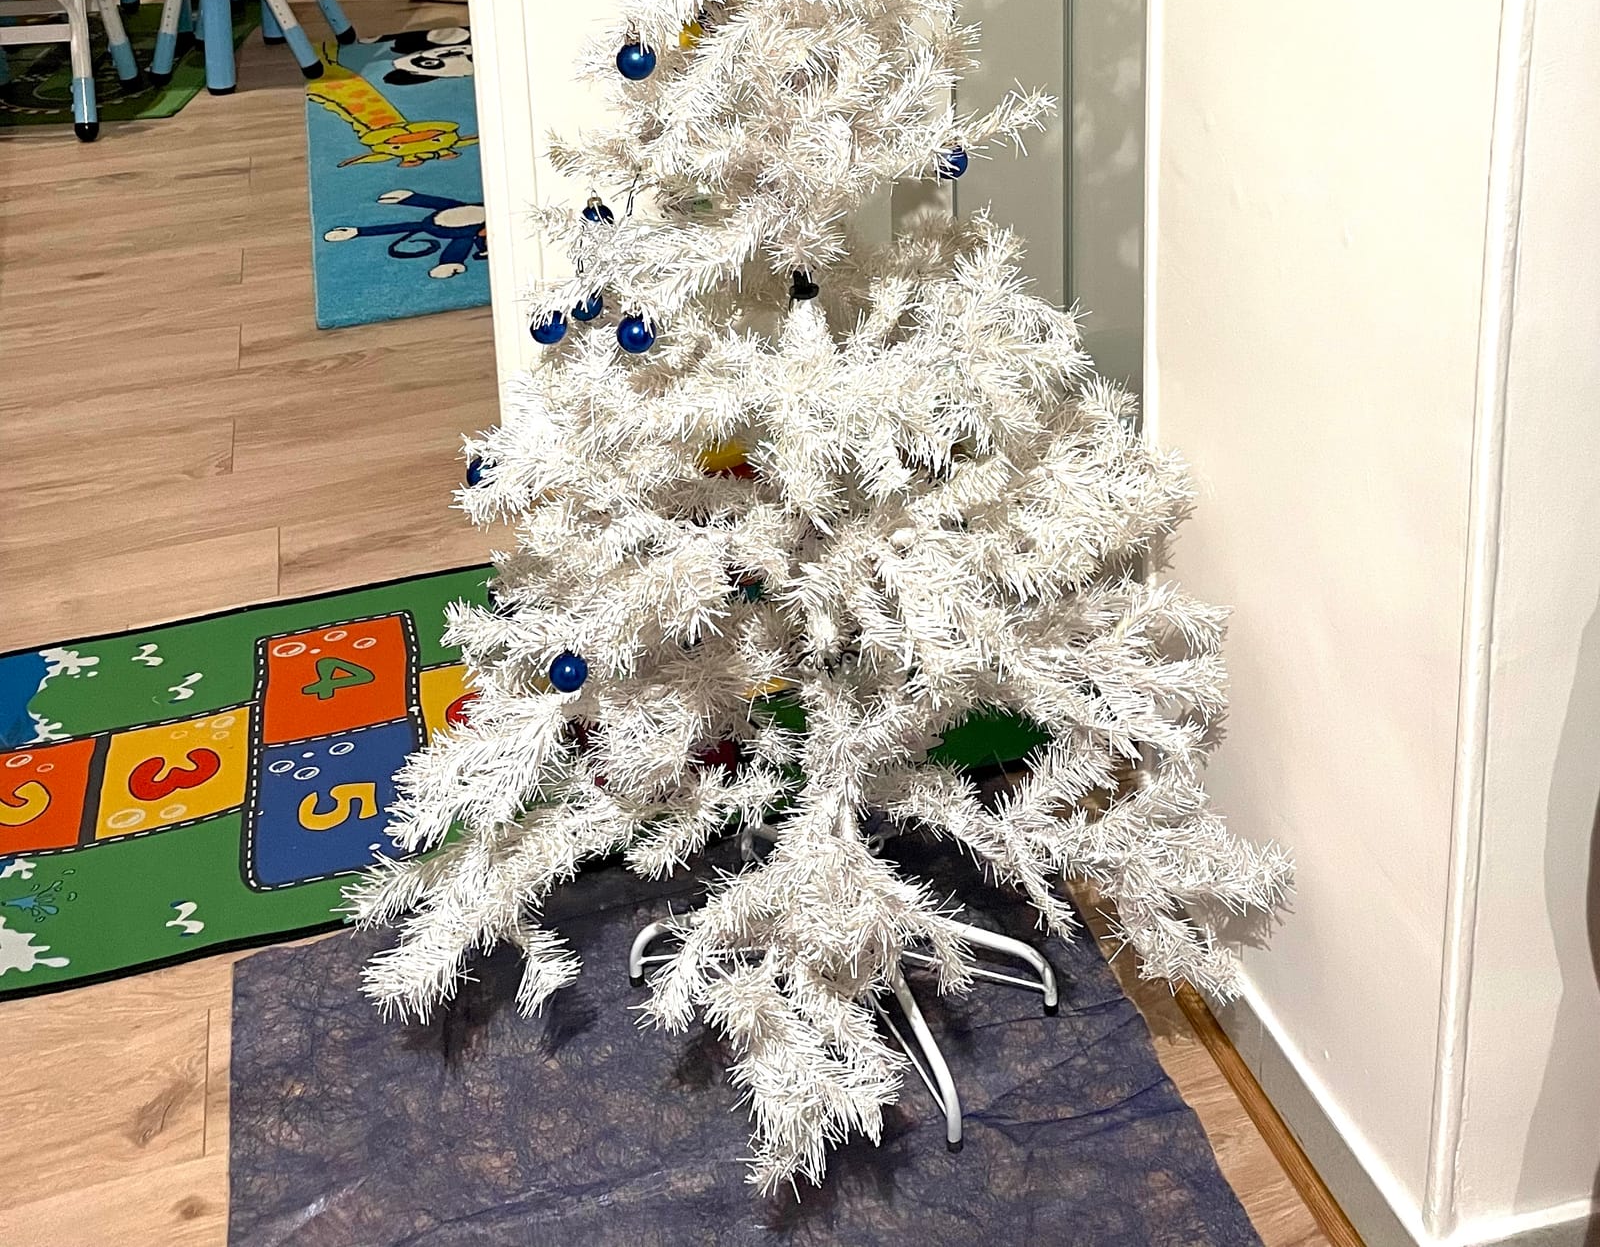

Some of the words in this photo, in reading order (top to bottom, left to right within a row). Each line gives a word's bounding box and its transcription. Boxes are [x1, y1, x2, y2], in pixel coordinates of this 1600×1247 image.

[302, 658, 375, 699] 4
[128, 748, 220, 801] 3
[298, 782, 377, 831] 5
